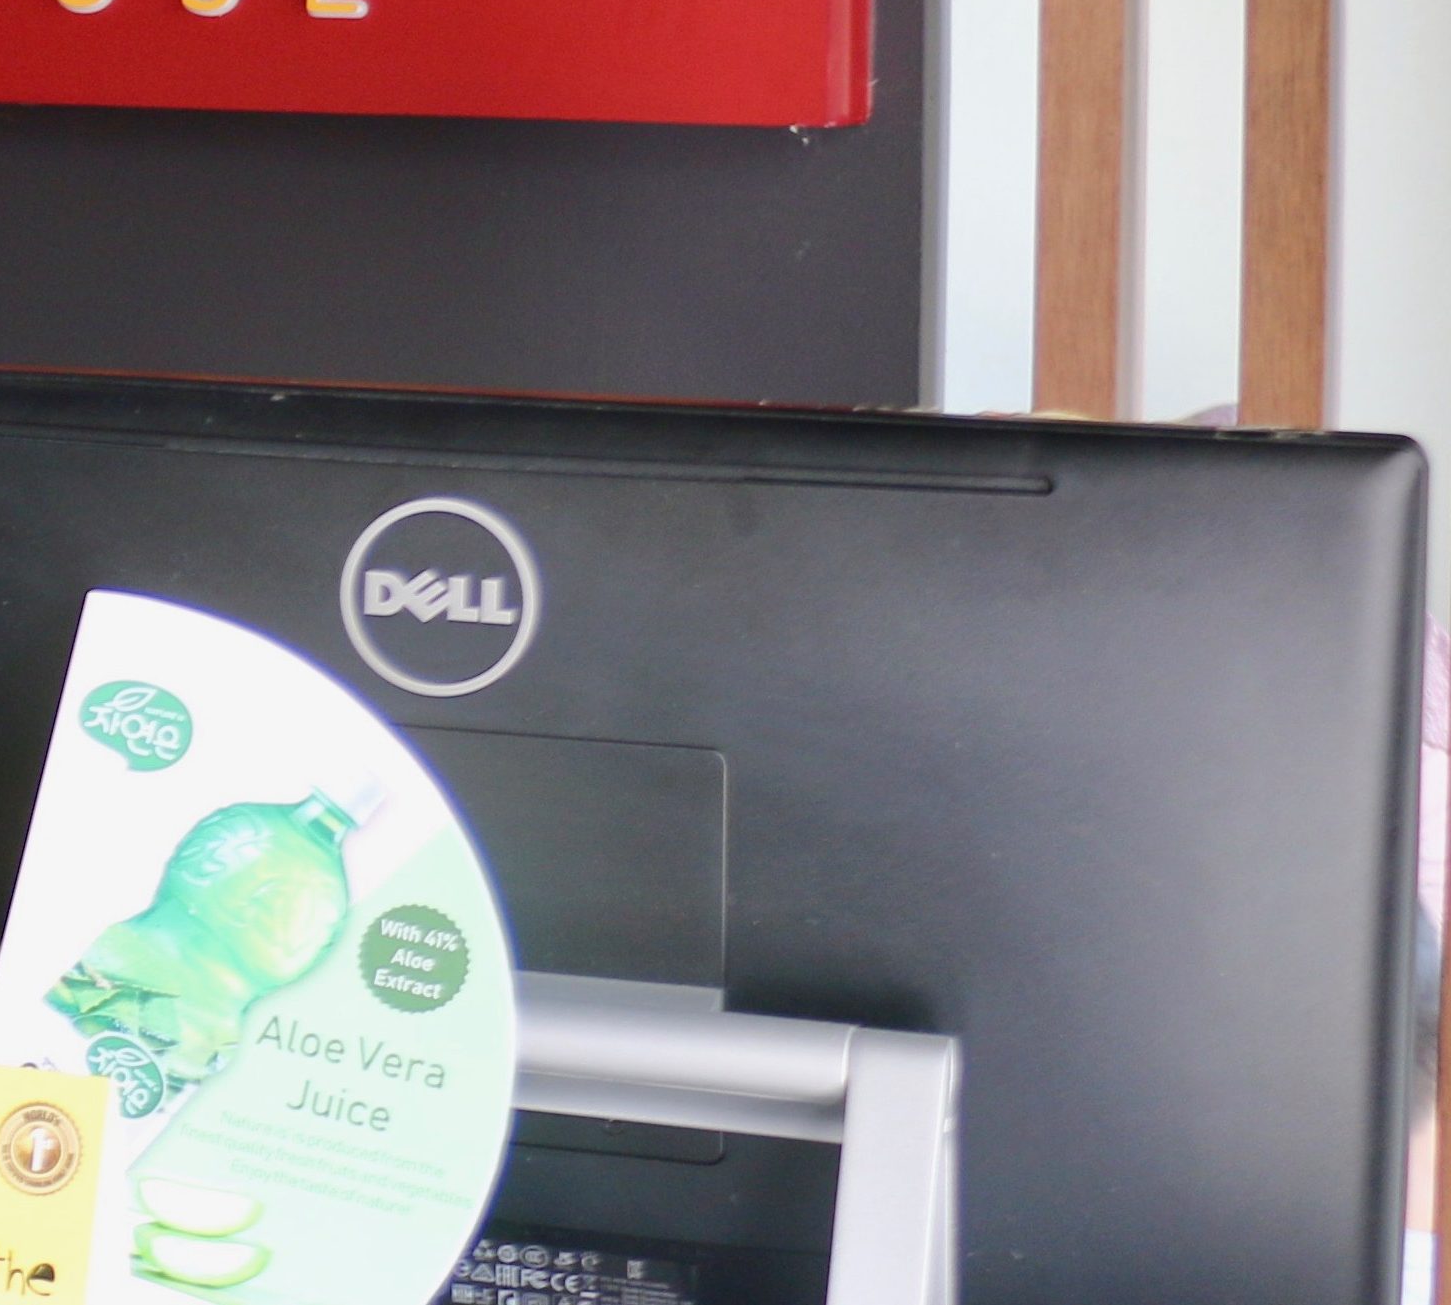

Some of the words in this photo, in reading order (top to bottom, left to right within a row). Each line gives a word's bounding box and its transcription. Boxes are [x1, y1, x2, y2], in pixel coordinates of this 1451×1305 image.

[363, 568, 522, 625] DELL
[380, 918, 421, 944] With
[422, 929, 460, 953] 41%
[390, 948, 436, 973] Aloe
[373, 967, 443, 1000] Extract
[256, 1014, 346, 1064] Aloe
[358, 1035, 447, 1090] Vera
[286, 1079, 391, 1132] Juice
